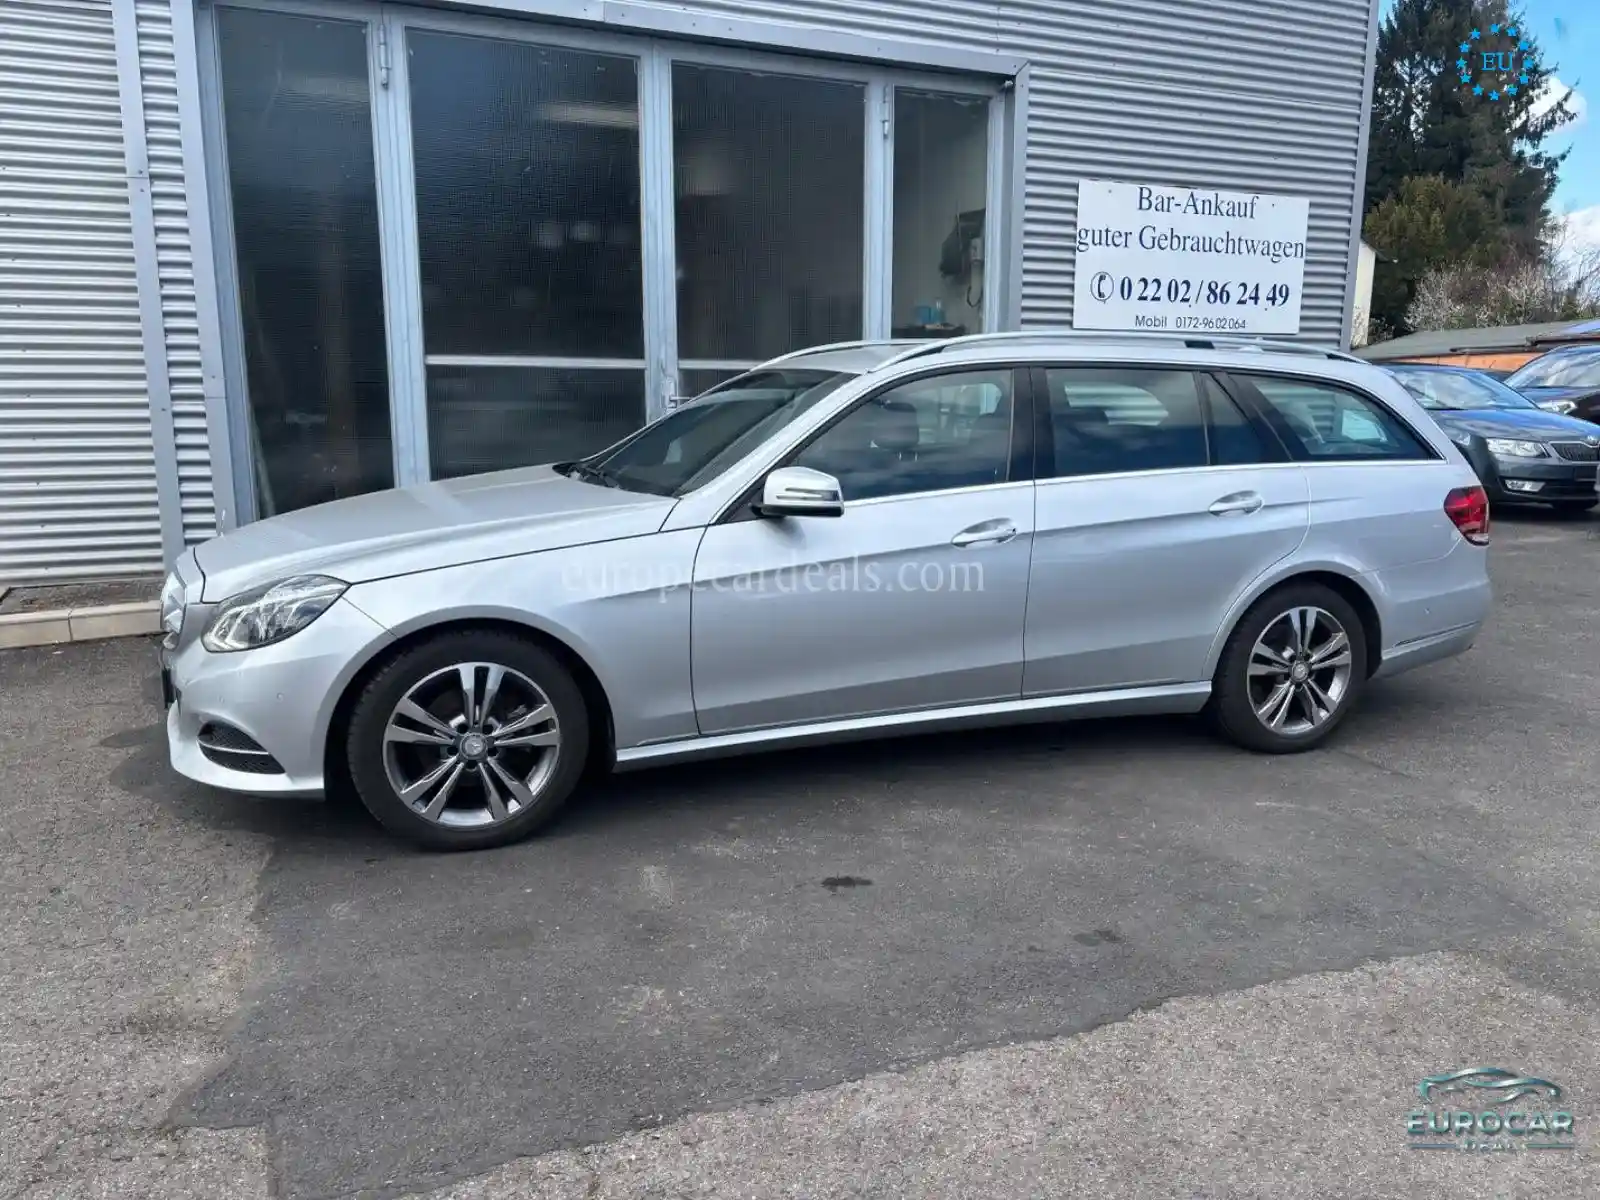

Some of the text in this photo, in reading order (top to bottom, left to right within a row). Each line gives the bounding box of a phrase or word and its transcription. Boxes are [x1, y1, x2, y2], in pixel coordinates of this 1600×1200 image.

[1137, 186, 1259, 219] Bar-Ankauf
[1076, 224, 1304, 263] guter Gebrauchtwagen
[1135, 315, 1167, 328] Mobil
